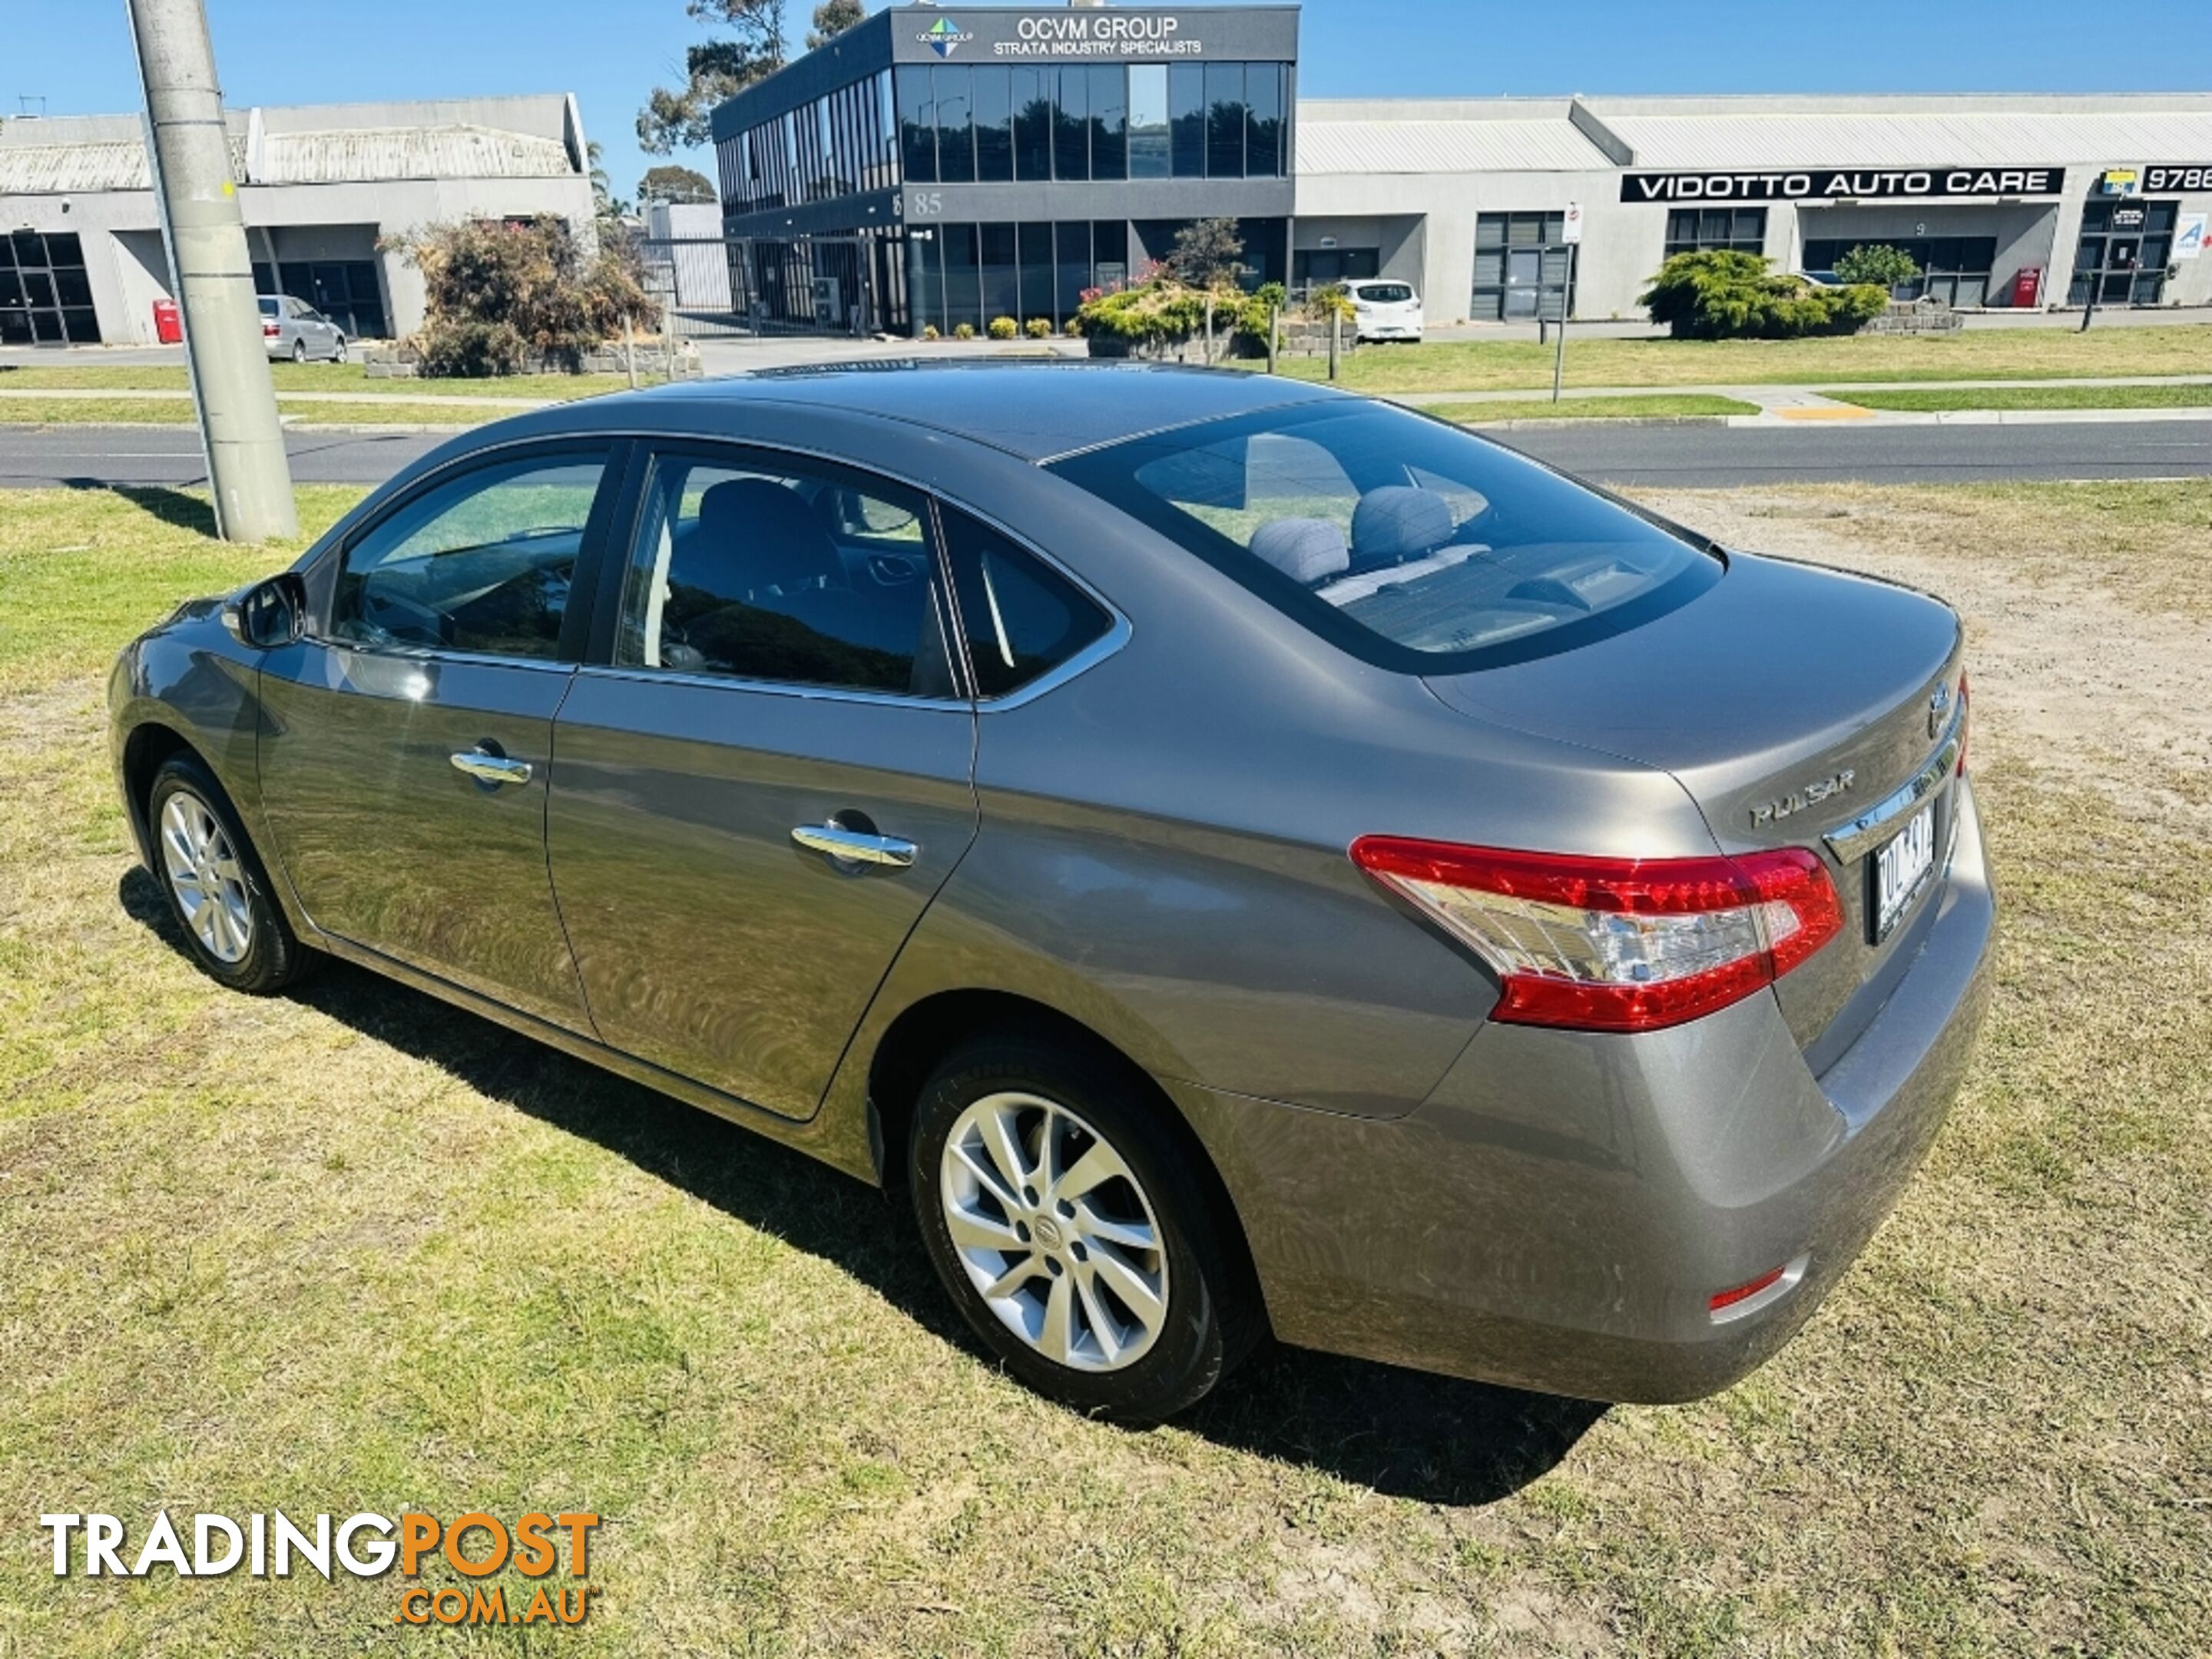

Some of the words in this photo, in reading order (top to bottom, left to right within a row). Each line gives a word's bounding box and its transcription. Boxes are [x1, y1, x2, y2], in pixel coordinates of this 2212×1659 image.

[1017, 17, 1088, 40] OCVM
[1093, 17, 1178, 39] GROUP
[993, 41, 1049, 55] STRATA
[1051, 41, 1117, 55] INDUSTRY
[1120, 41, 1203, 55] SPECIALISTS
[1637, 174, 1811, 199] VIDOTTO
[1823, 173, 1932, 195] AUTO
[1945, 171, 2050, 193] CARE
[914, 193, 942, 215] 85
[1749, 769, 1855, 829] PULSAR
